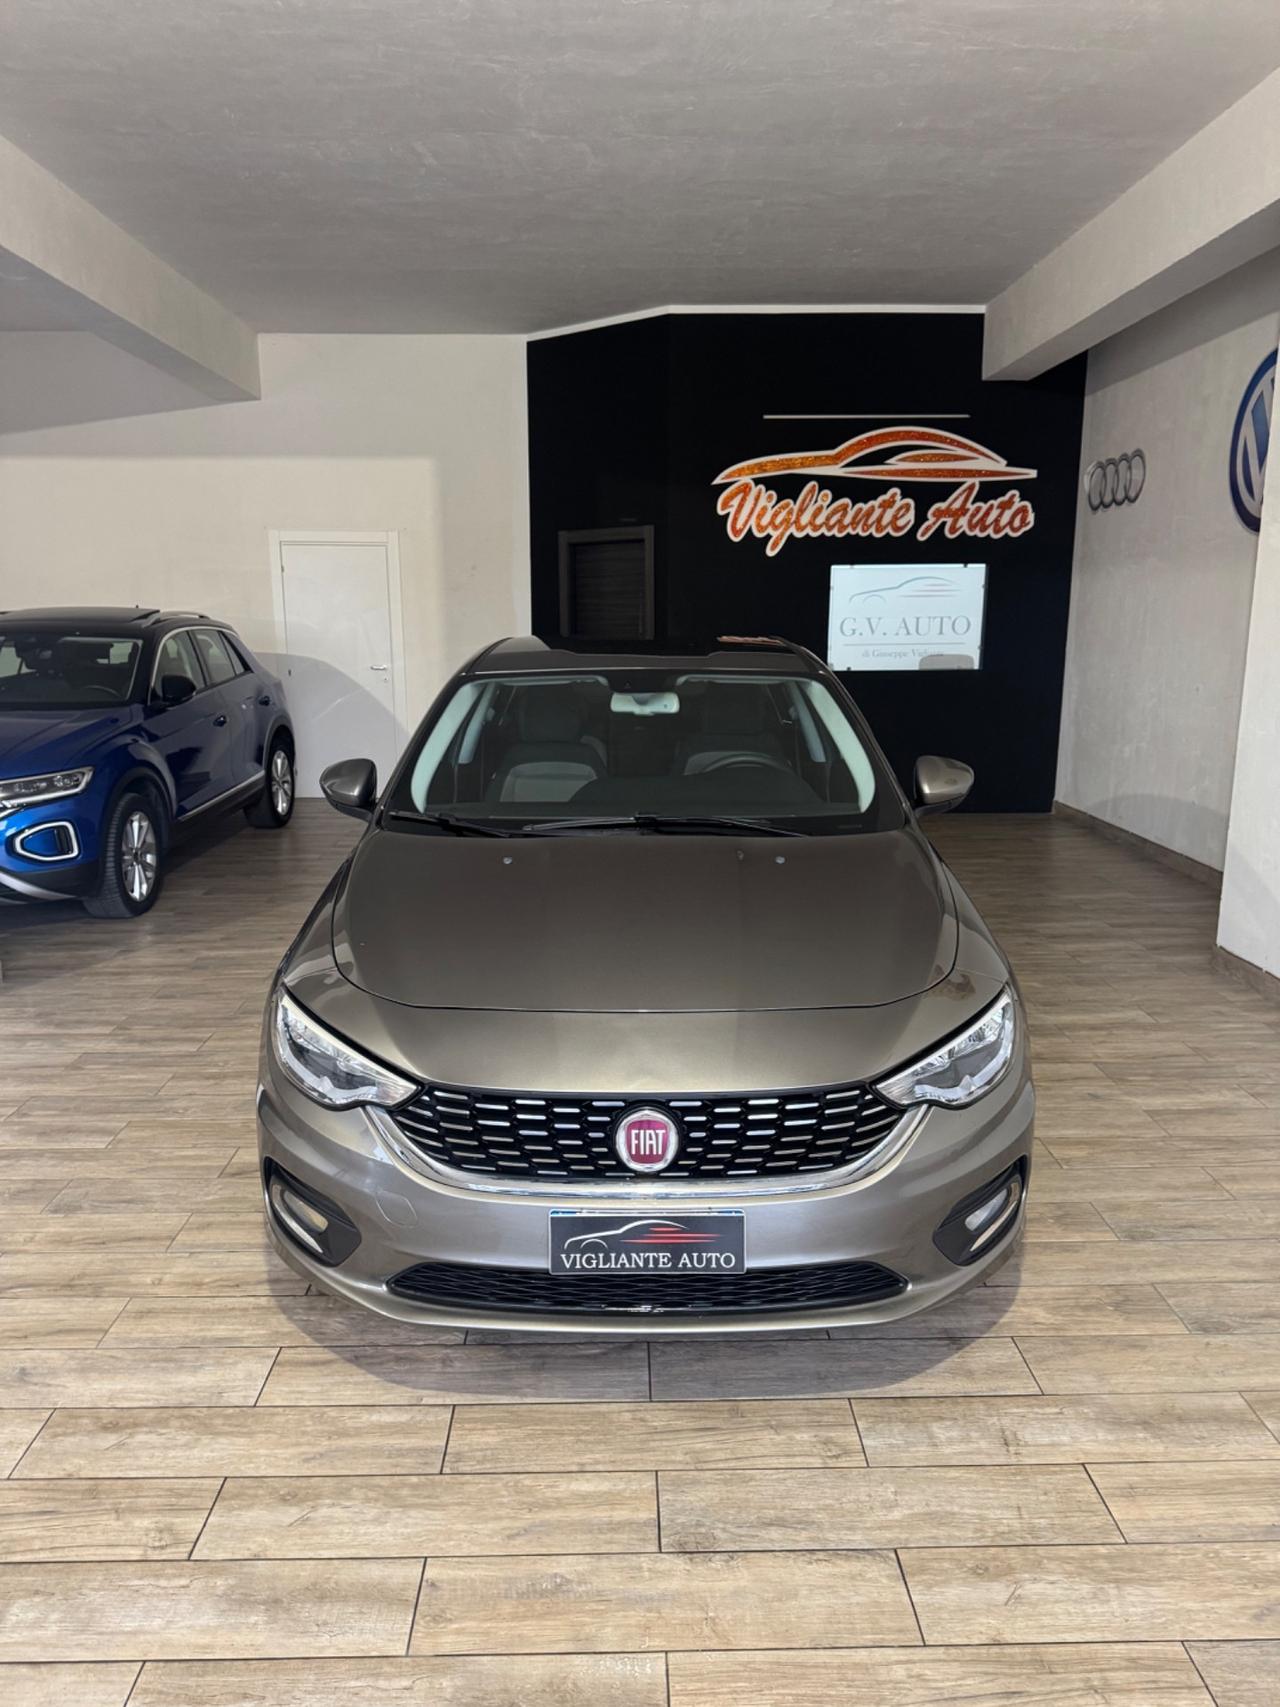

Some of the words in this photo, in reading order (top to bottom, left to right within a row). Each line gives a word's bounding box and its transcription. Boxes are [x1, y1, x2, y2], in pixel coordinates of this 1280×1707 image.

[717, 477, 915, 557] Vigliante
[916, 480, 1035, 541] Auto
[839, 616, 888, 637] G.V.
[894, 614, 971, 637] AUTO
[630, 1128, 667, 1156] FIAT
[560, 1252, 672, 1270] VIGLIANTE
[678, 1252, 736, 1269] AUTO
